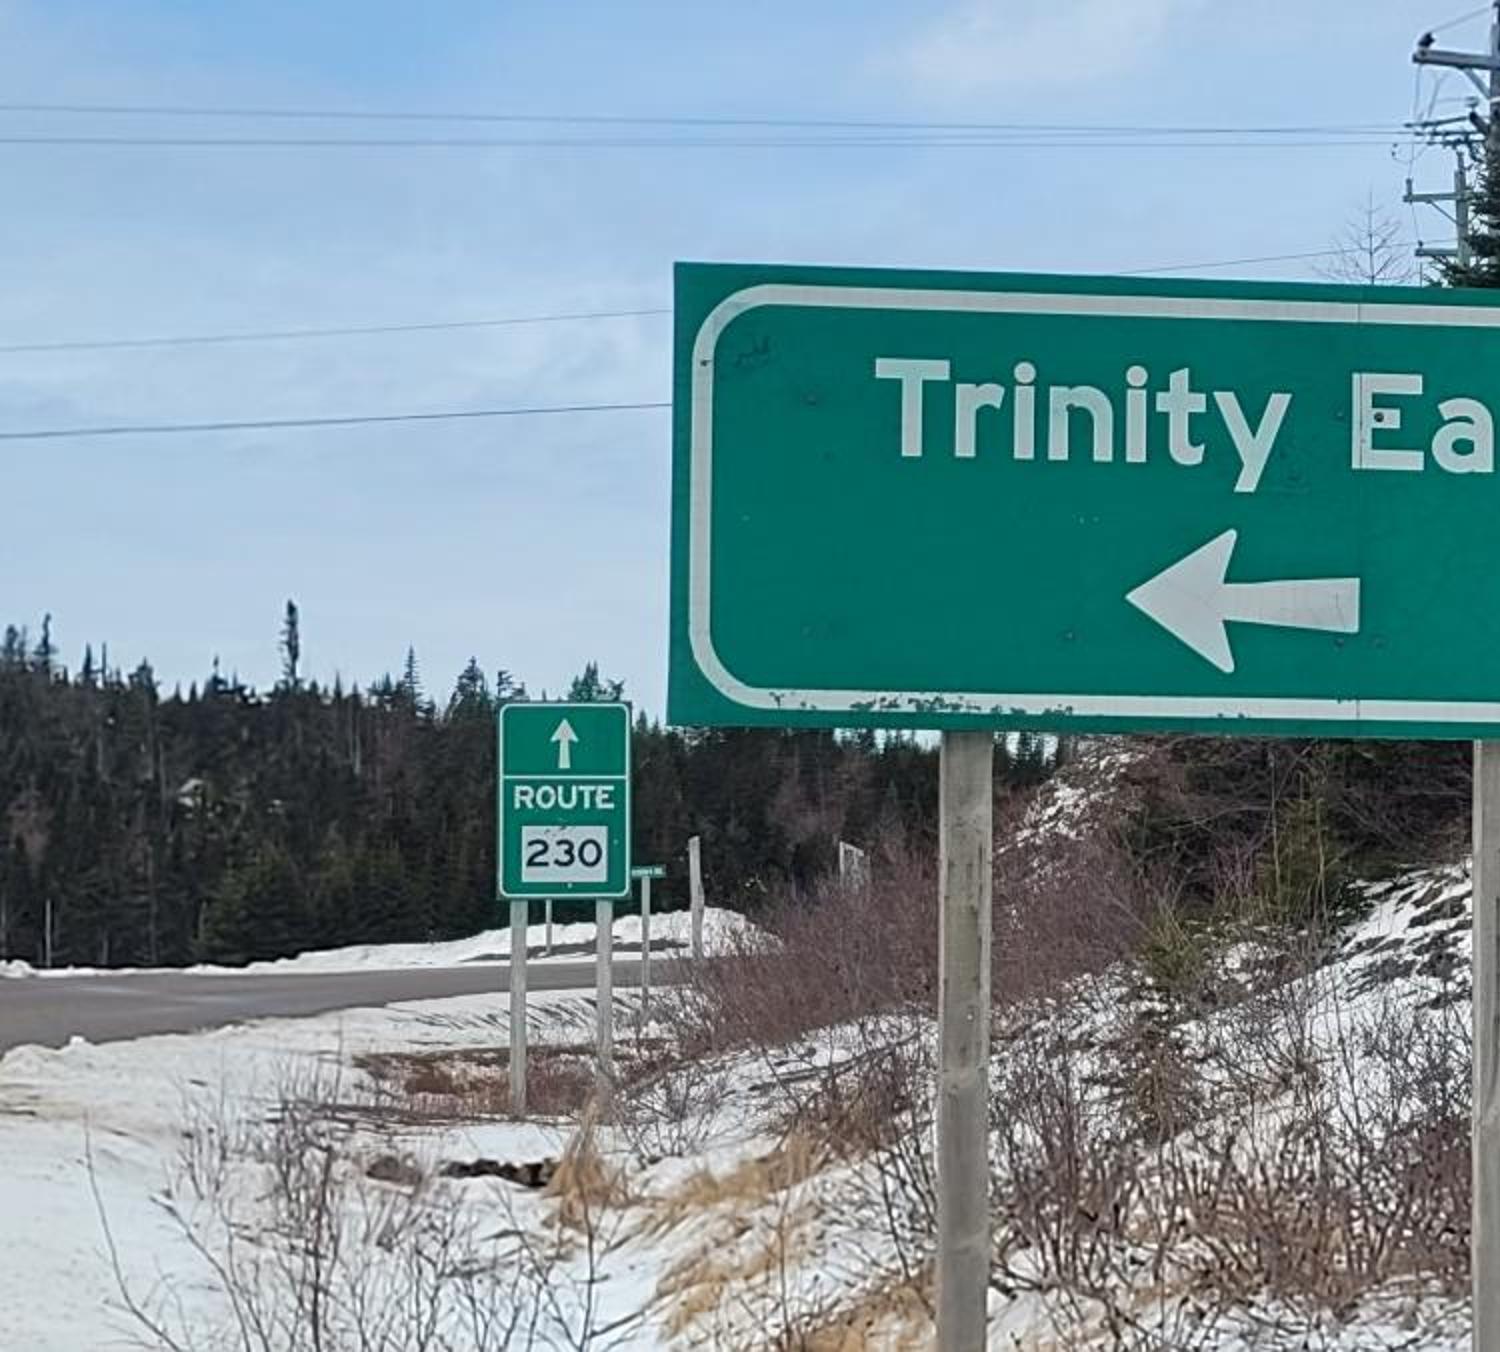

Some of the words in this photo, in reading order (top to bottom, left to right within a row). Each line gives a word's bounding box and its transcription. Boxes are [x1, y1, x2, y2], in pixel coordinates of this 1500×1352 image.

[875, 358, 1292, 493] Trinity
[513, 785, 615, 810] ROUTE
[525, 838, 603, 868] 230
